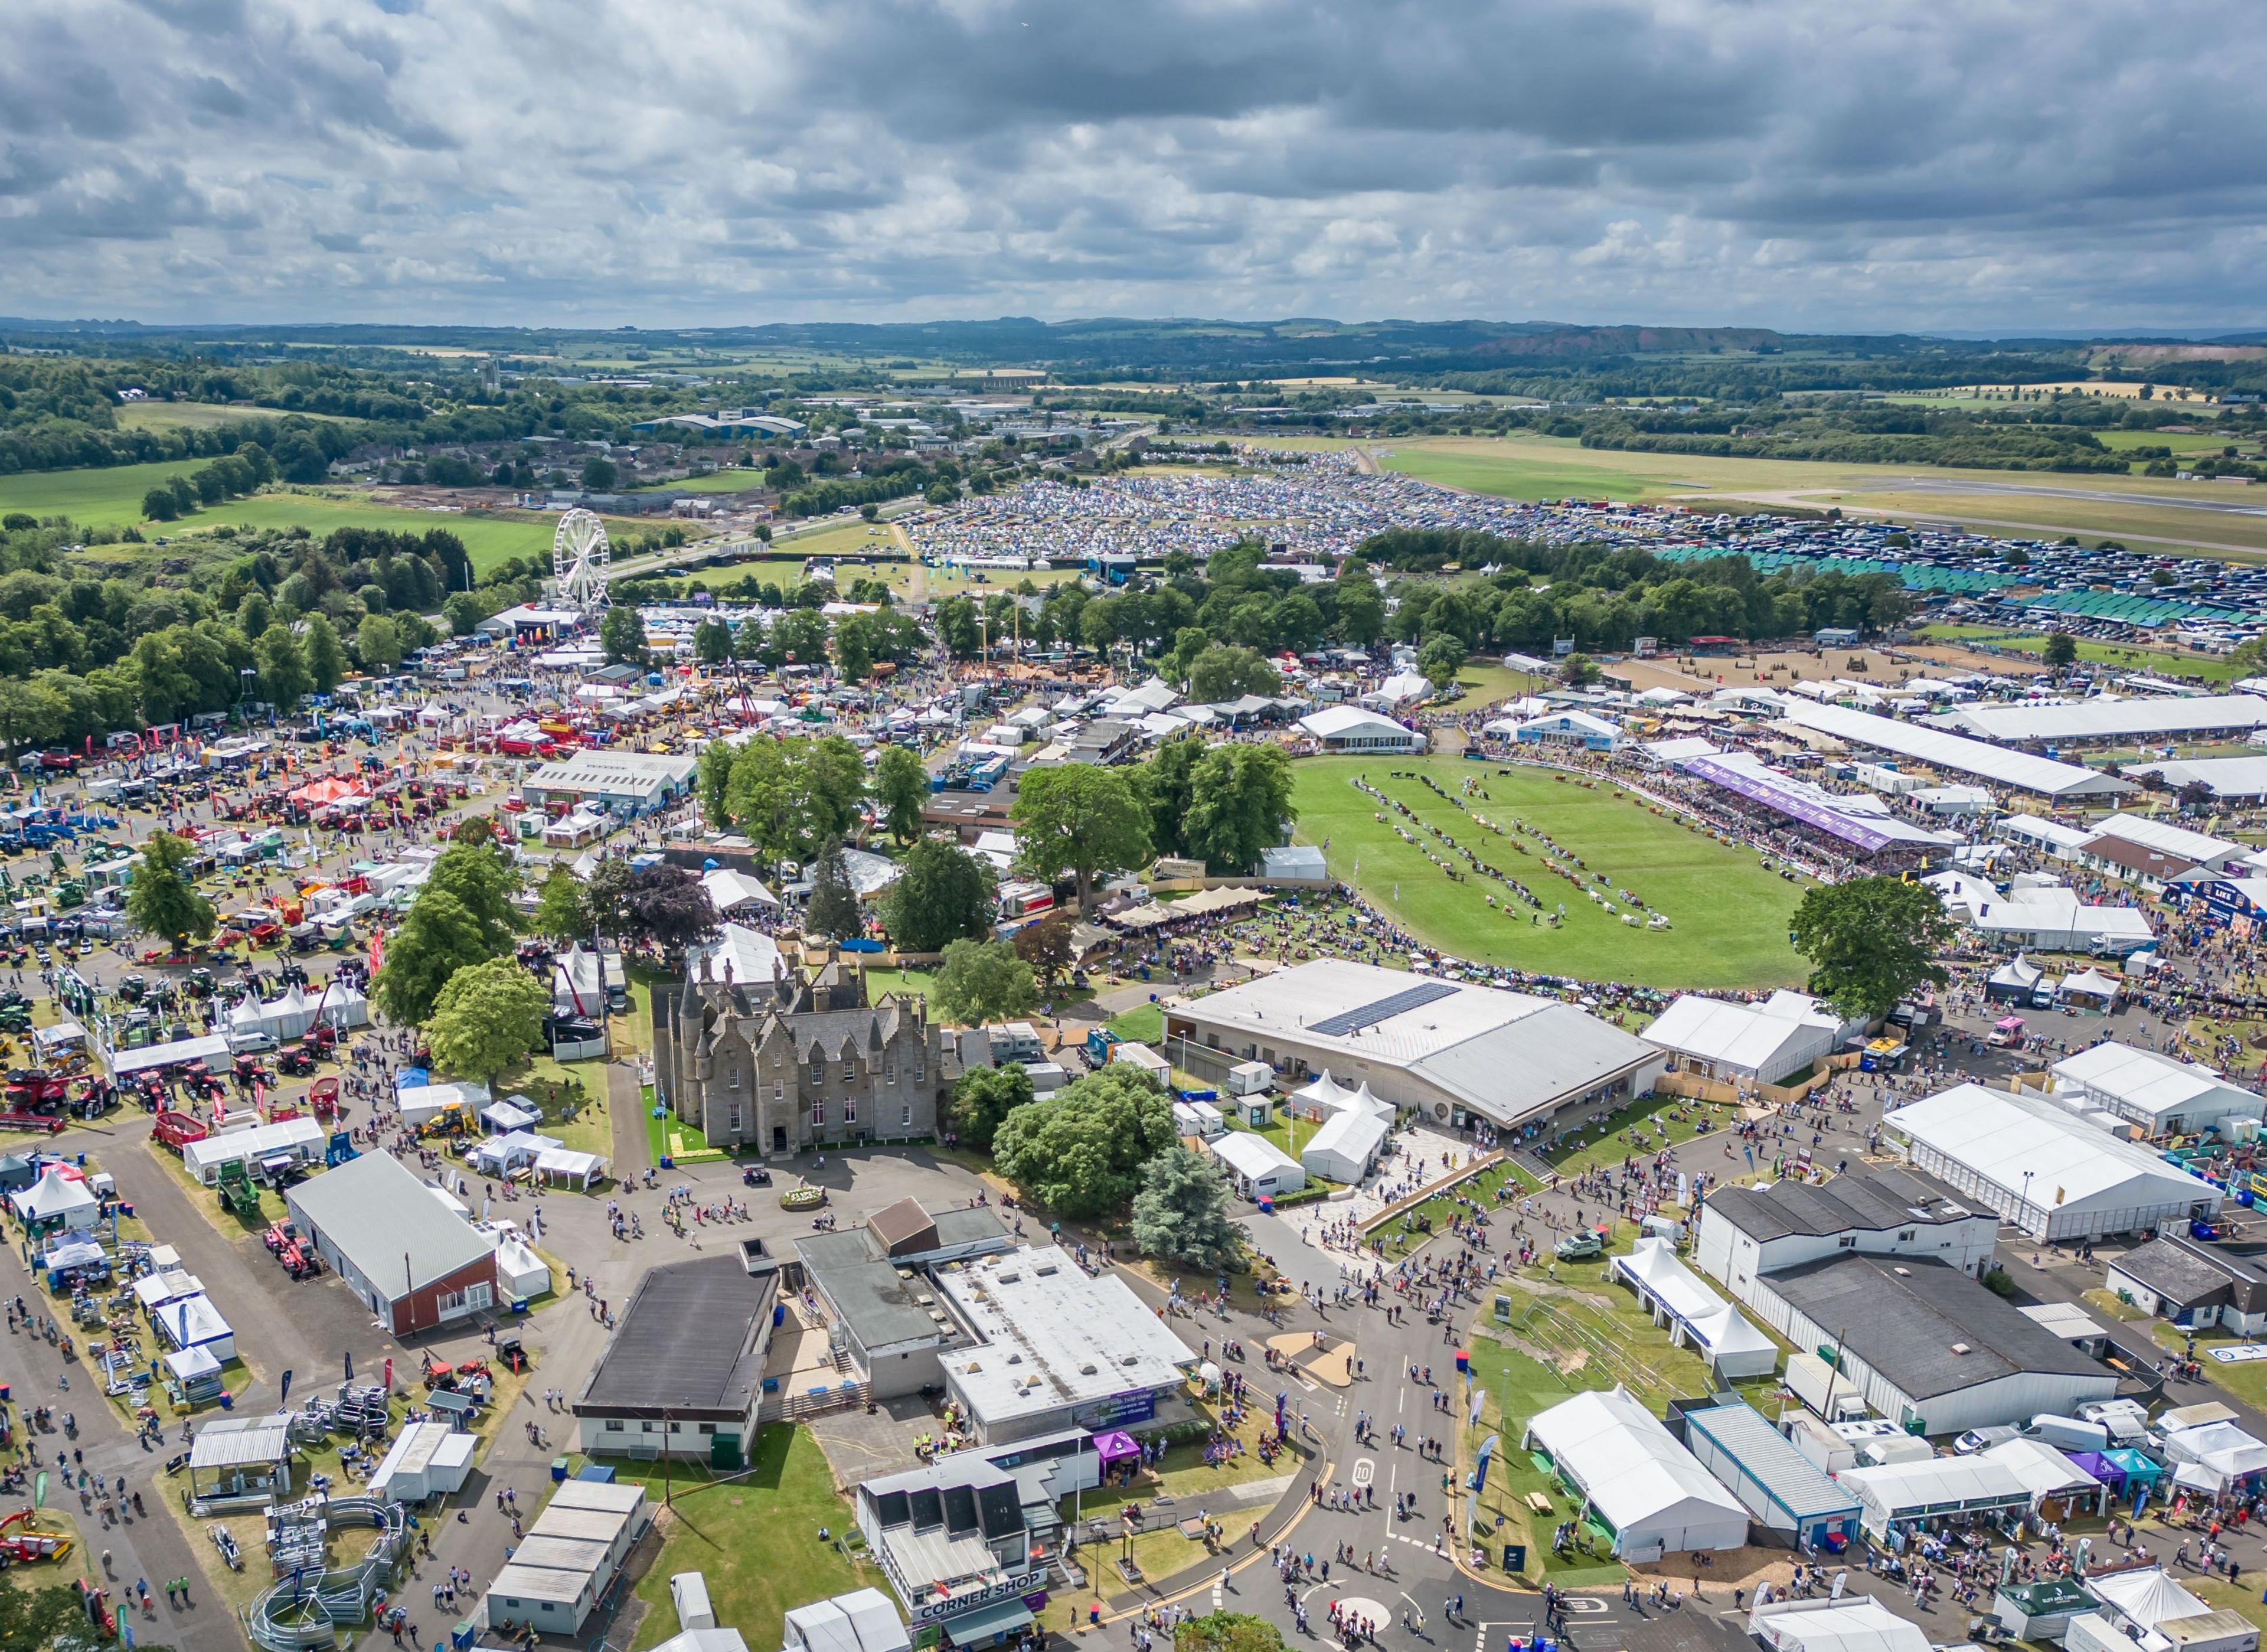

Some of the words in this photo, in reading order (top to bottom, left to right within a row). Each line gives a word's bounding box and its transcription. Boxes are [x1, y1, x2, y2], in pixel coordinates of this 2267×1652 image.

[2216, 890, 2232, 900] LIKE
[1357, 1467, 1368, 1480] 10
[922, 1589, 993, 1618] CORNER
[995, 1573, 1040, 1595] SHOP
